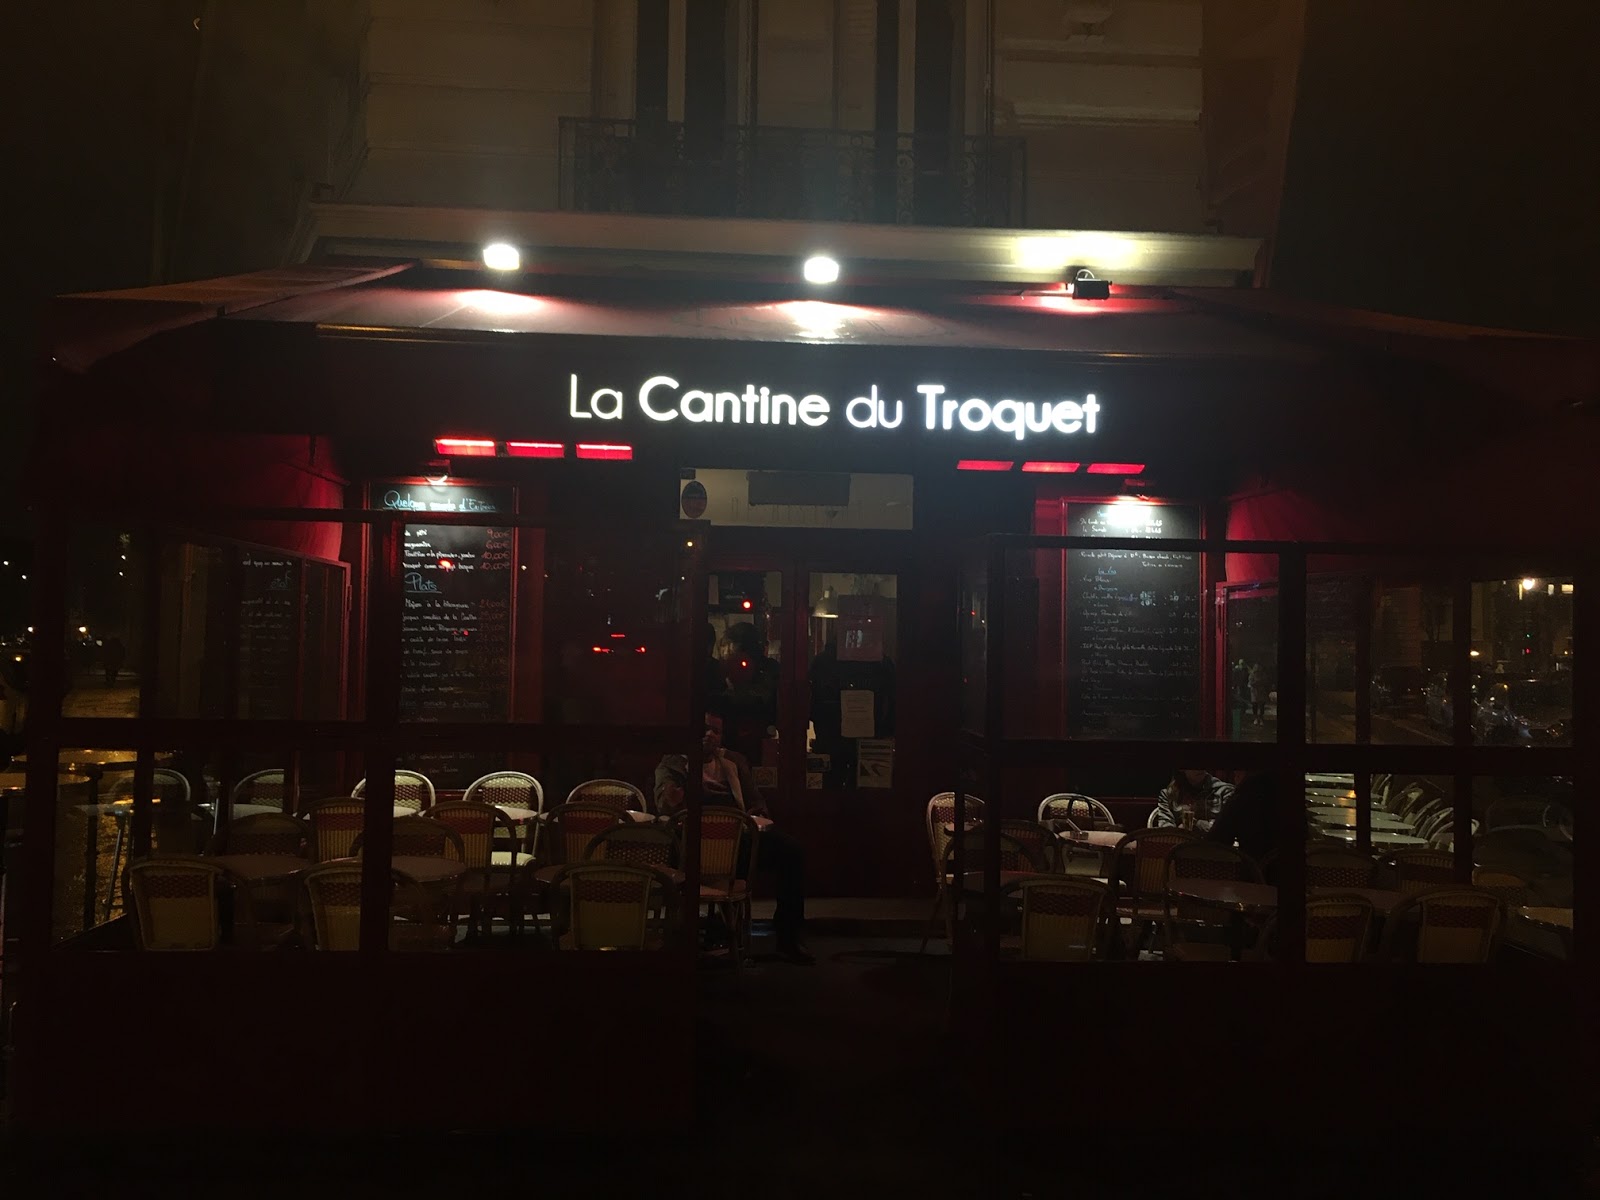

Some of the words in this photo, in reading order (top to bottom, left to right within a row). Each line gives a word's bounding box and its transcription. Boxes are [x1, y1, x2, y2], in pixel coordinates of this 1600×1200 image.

[570, 374, 623, 419] La
[639, 376, 830, 426] Cantine
[846, 384, 903, 429] du
[917, 384, 1100, 441] Troquet
[405, 572, 438, 591] Plats
